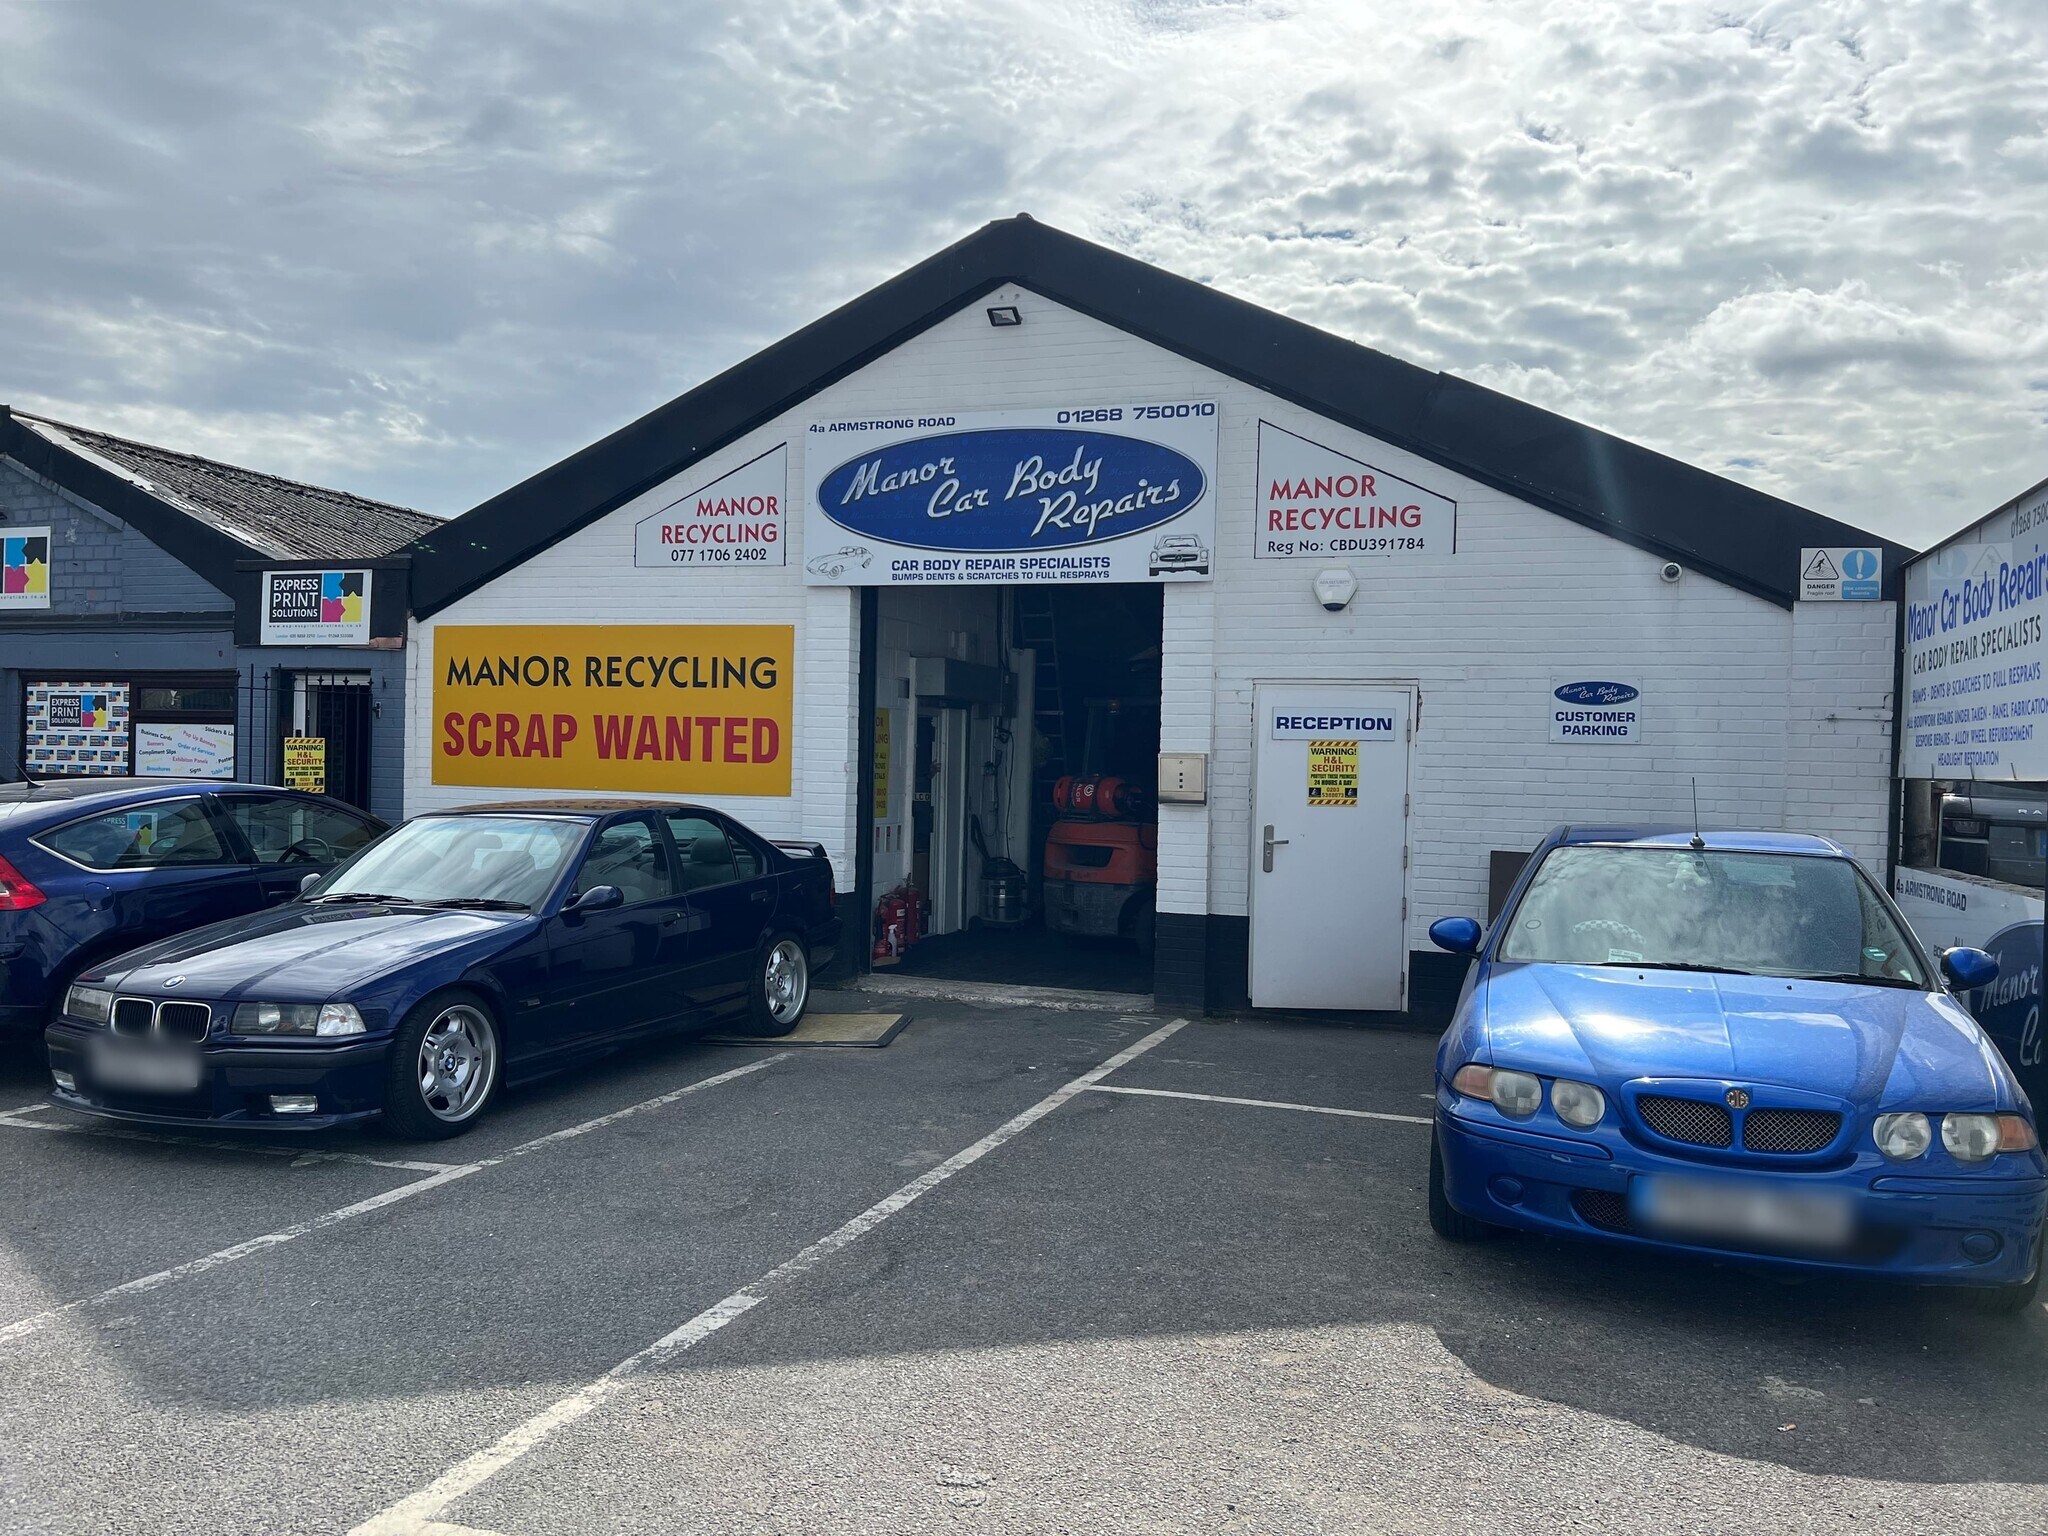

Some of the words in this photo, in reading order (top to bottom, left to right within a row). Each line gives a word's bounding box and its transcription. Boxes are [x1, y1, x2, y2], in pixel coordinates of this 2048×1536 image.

[1057, 408, 1123, 424] 01268
[1133, 402, 1215, 420] 750010
[809, 424, 825, 433] 4a
[828, 419, 914, 432] ARMSTRONG
[918, 416, 956, 427] ROAD
[840, 456, 956, 505] Manor
[1003, 445, 1103, 501] Body
[1269, 475, 1377, 501] MANOR
[696, 496, 779, 517] MANOR
[927, 478, 989, 518] Car
[1030, 478, 1181, 537] Repairs
[1268, 505, 1422, 531] RECYCLING
[661, 523, 777, 544] RECYCLING
[671, 549, 694, 562] 077
[699, 548, 731, 561] 1706
[735, 548, 767, 561] 2402
[1268, 541, 1294, 555] Reg
[1299, 540, 1324, 552] No:
[1330, 538, 1425, 551] CBDU391784
[891, 559, 919, 571] CAR
[923, 559, 961, 571] BODY
[965, 558, 1015, 570] REPAIR
[1019, 556, 1111, 570] SPECIALISTS
[891, 573, 924, 581] BUMPS
[926, 573, 955, 581] DENTS
[966, 572, 1019, 580] SCRATCHES
[1036, 571, 1057, 579] FULL
[1060, 570, 1110, 579] RESPRAYS
[273, 579, 319, 591] EXPRESS
[273, 592, 319, 607] PRINT
[1908, 602, 1938, 644] Manor
[1941, 588, 1960, 633] Car
[1963, 570, 1995, 625] Body
[272, 608, 318, 618] SOLUTIONS
[1913, 652, 1927, 675] CAR
[1928, 644, 1948, 671] BODY
[1950, 635, 1978, 665] REPAIR
[1981, 614, 2041, 657] SPECIALISTS
[446, 655, 572, 687] MANOR
[585, 656, 777, 690] RECYCLING
[1560, 686, 1586, 695] Manor
[1596, 685, 1618, 695] Body
[1912, 687, 1926, 704] BUMPS
[1930, 683, 1945, 700] DENTS
[1952, 676, 1981, 696] SCRATCHES
[1983, 674, 1991, 690] TO
[1993, 669, 2006, 688] FULL
[2008, 661, 2040, 685] RESPRAYS
[51, 698, 80, 707] EXPRESS
[1579, 690, 1593, 699] Car
[1602, 691, 1634, 703] Repairs
[51, 707, 80, 717] PRINT
[1555, 711, 1636, 722] CUSTOMER
[1937, 711, 1953, 726] REPAIRS
[1955, 708, 1969, 724] UNDER
[1971, 706, 1987, 721] TAKEN
[1993, 703, 2009, 719] PANEL
[1276, 716, 1392, 731] RECEPTION
[1562, 725, 1628, 736] PARKING
[443, 712, 578, 758] SCRAP
[593, 714, 780, 764] WANTED
[1934, 732, 1950, 746] REPAIRS
[1954, 730, 1969, 745] ALLOY
[1971, 729, 1987, 743] WHEEL
[1989, 724, 2033, 742] REFURBISHMENT
[1310, 748, 1357, 756] WARNING!
[1938, 752, 1963, 766] HEADLIGHT
[1964, 751, 1999, 766] RESTORATION
[1311, 764, 1356, 772] SECURITY
[1896, 878, 1904, 894] 4a
[1904, 880, 1945, 905] ARMSTRONG
[1946, 889, 1967, 912] ROAD
